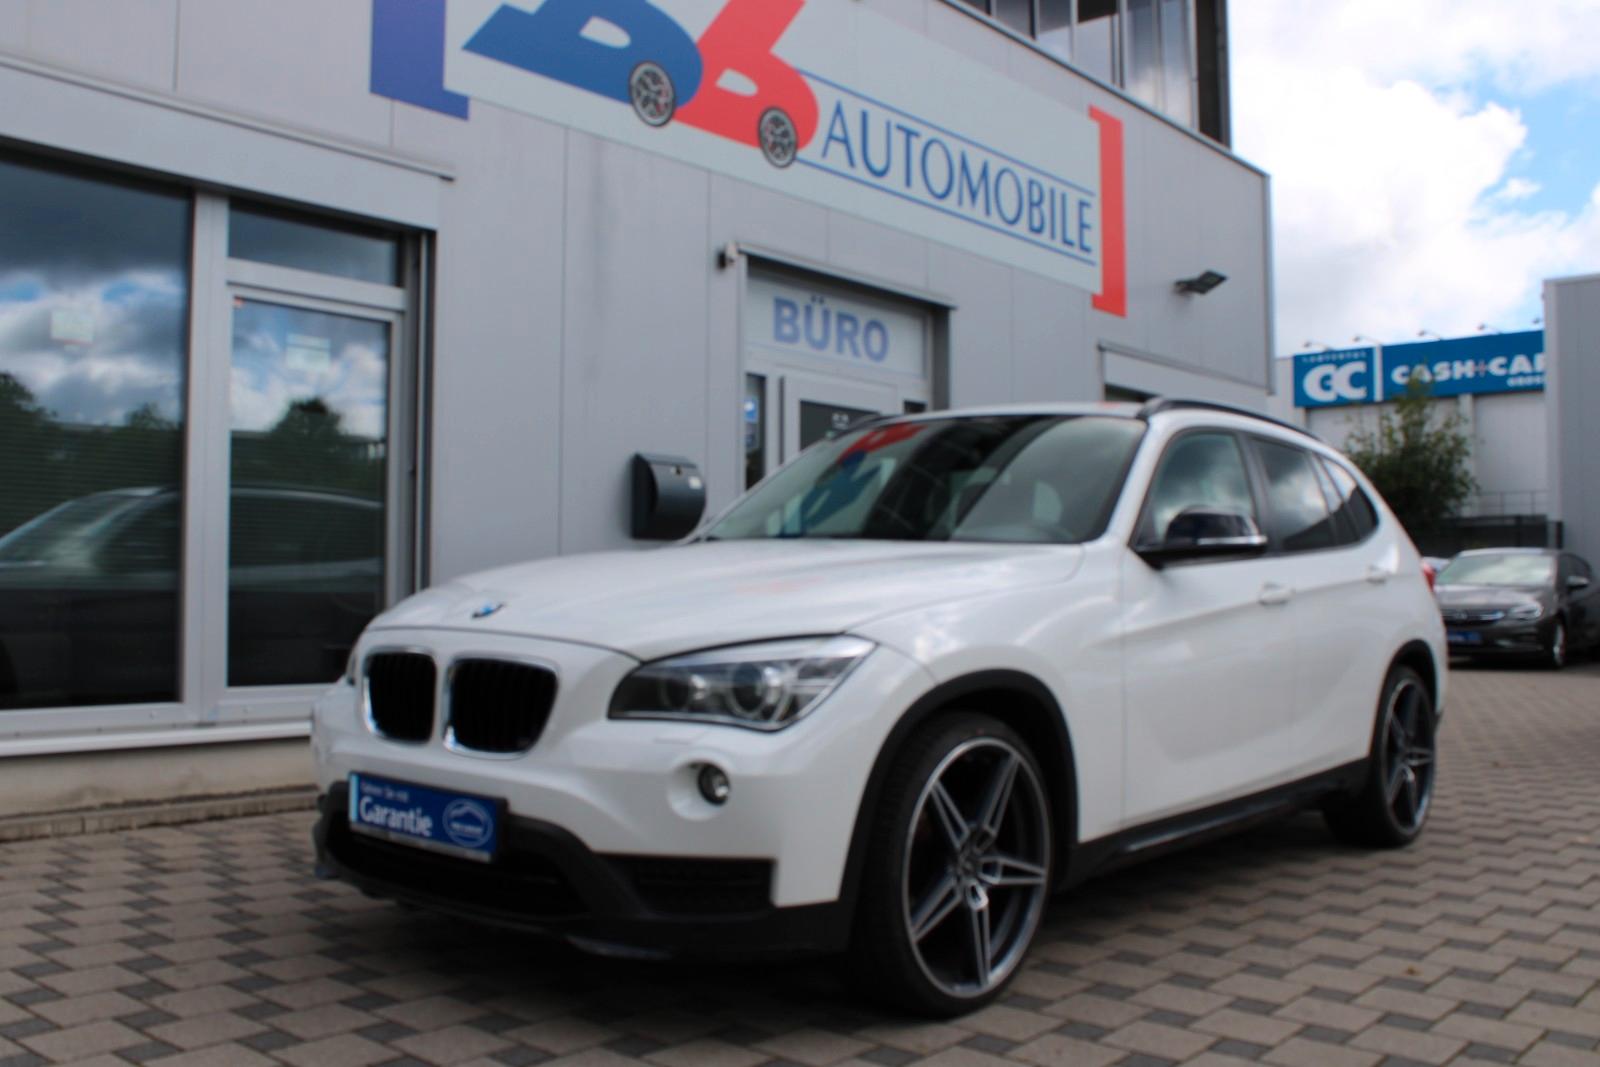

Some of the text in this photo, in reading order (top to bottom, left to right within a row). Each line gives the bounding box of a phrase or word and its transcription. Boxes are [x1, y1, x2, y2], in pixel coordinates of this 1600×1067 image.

[822, 100, 1093, 254] AUTOMOBILE
[773, 295, 890, 363] BÜRO
[359, 796, 433, 838] Garantie
